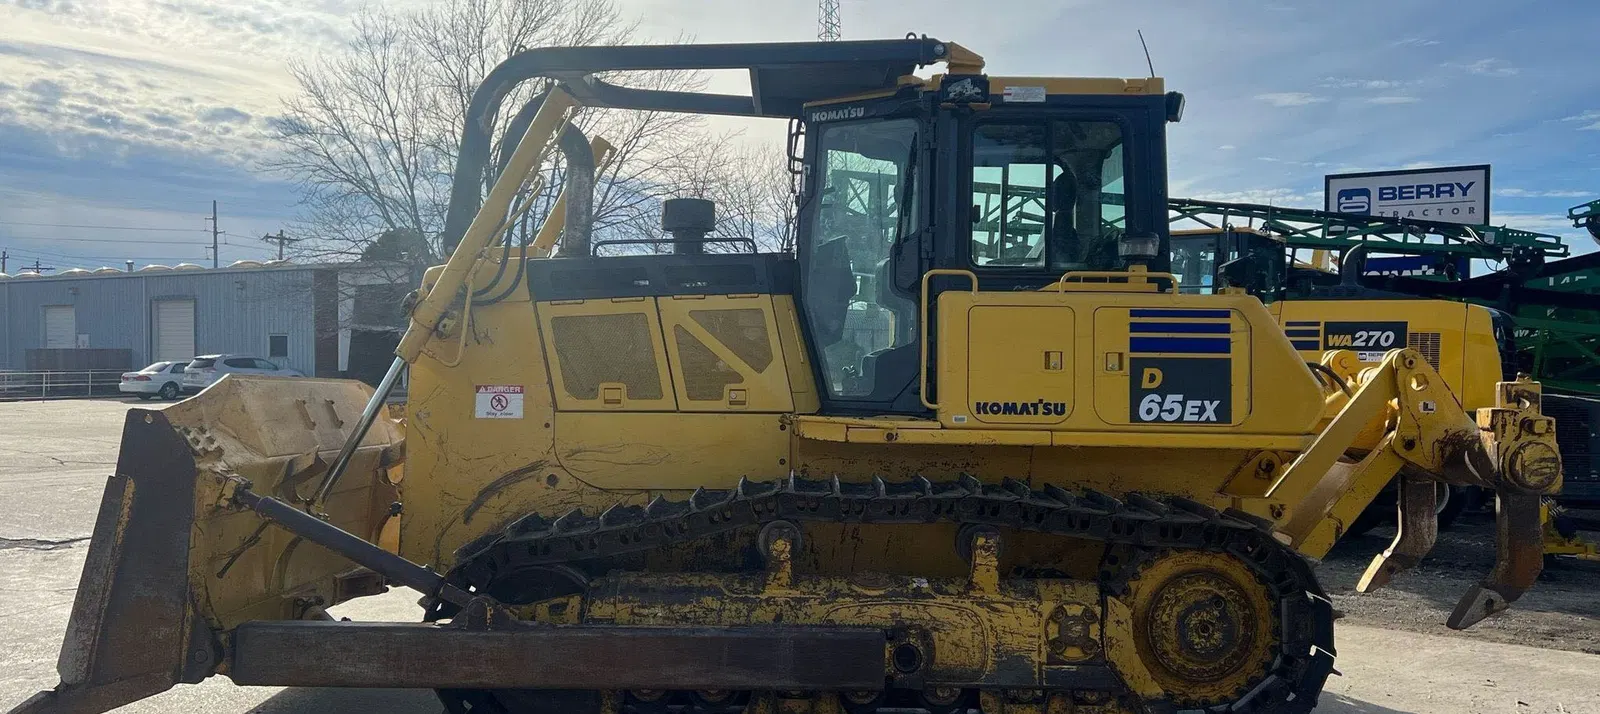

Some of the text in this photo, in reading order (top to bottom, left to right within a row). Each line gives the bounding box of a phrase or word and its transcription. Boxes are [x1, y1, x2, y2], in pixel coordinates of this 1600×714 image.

[812, 106, 865, 122] KOMATSU
[1378, 181, 1476, 201] BERRY
[1378, 206, 1476, 218] TRACTOR
[1327, 330, 1396, 347] WA270
[1141, 367, 1163, 389] D
[975, 399, 1066, 416] KOMATSU
[1138, 393, 1221, 422] 65EX
